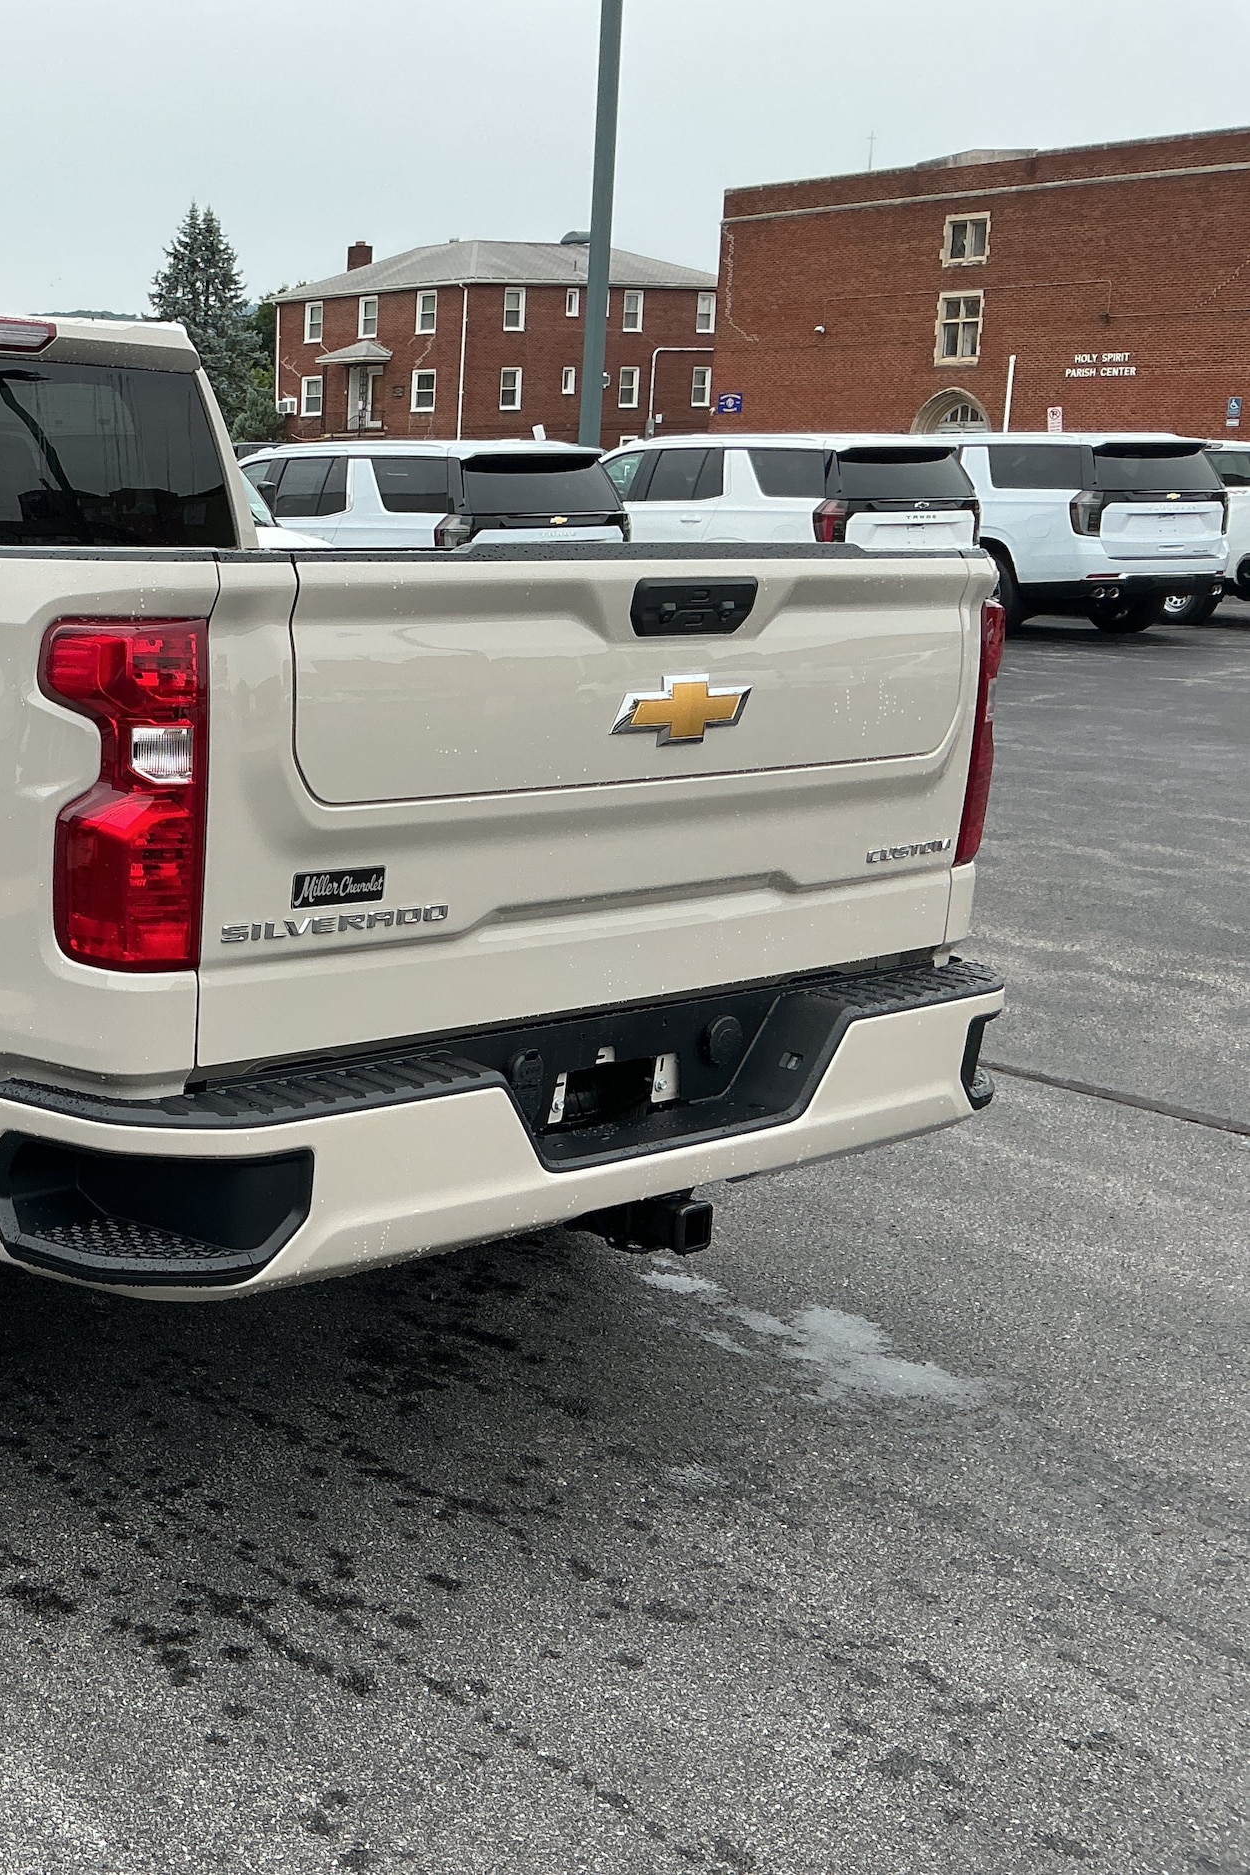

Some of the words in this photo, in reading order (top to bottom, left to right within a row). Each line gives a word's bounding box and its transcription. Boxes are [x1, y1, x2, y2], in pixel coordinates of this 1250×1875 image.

[1074, 353, 1098, 364] HOLY
[1101, 352, 1130, 363] SPIRIT
[1065, 367, 1096, 378] PARISH
[1100, 366, 1137, 377] CENTER
[865, 837, 952, 864] CUSTOM
[293, 874, 339, 907] Miller
[339, 872, 384, 898] Chevrolet
[220, 903, 449, 944] SILVERADO
